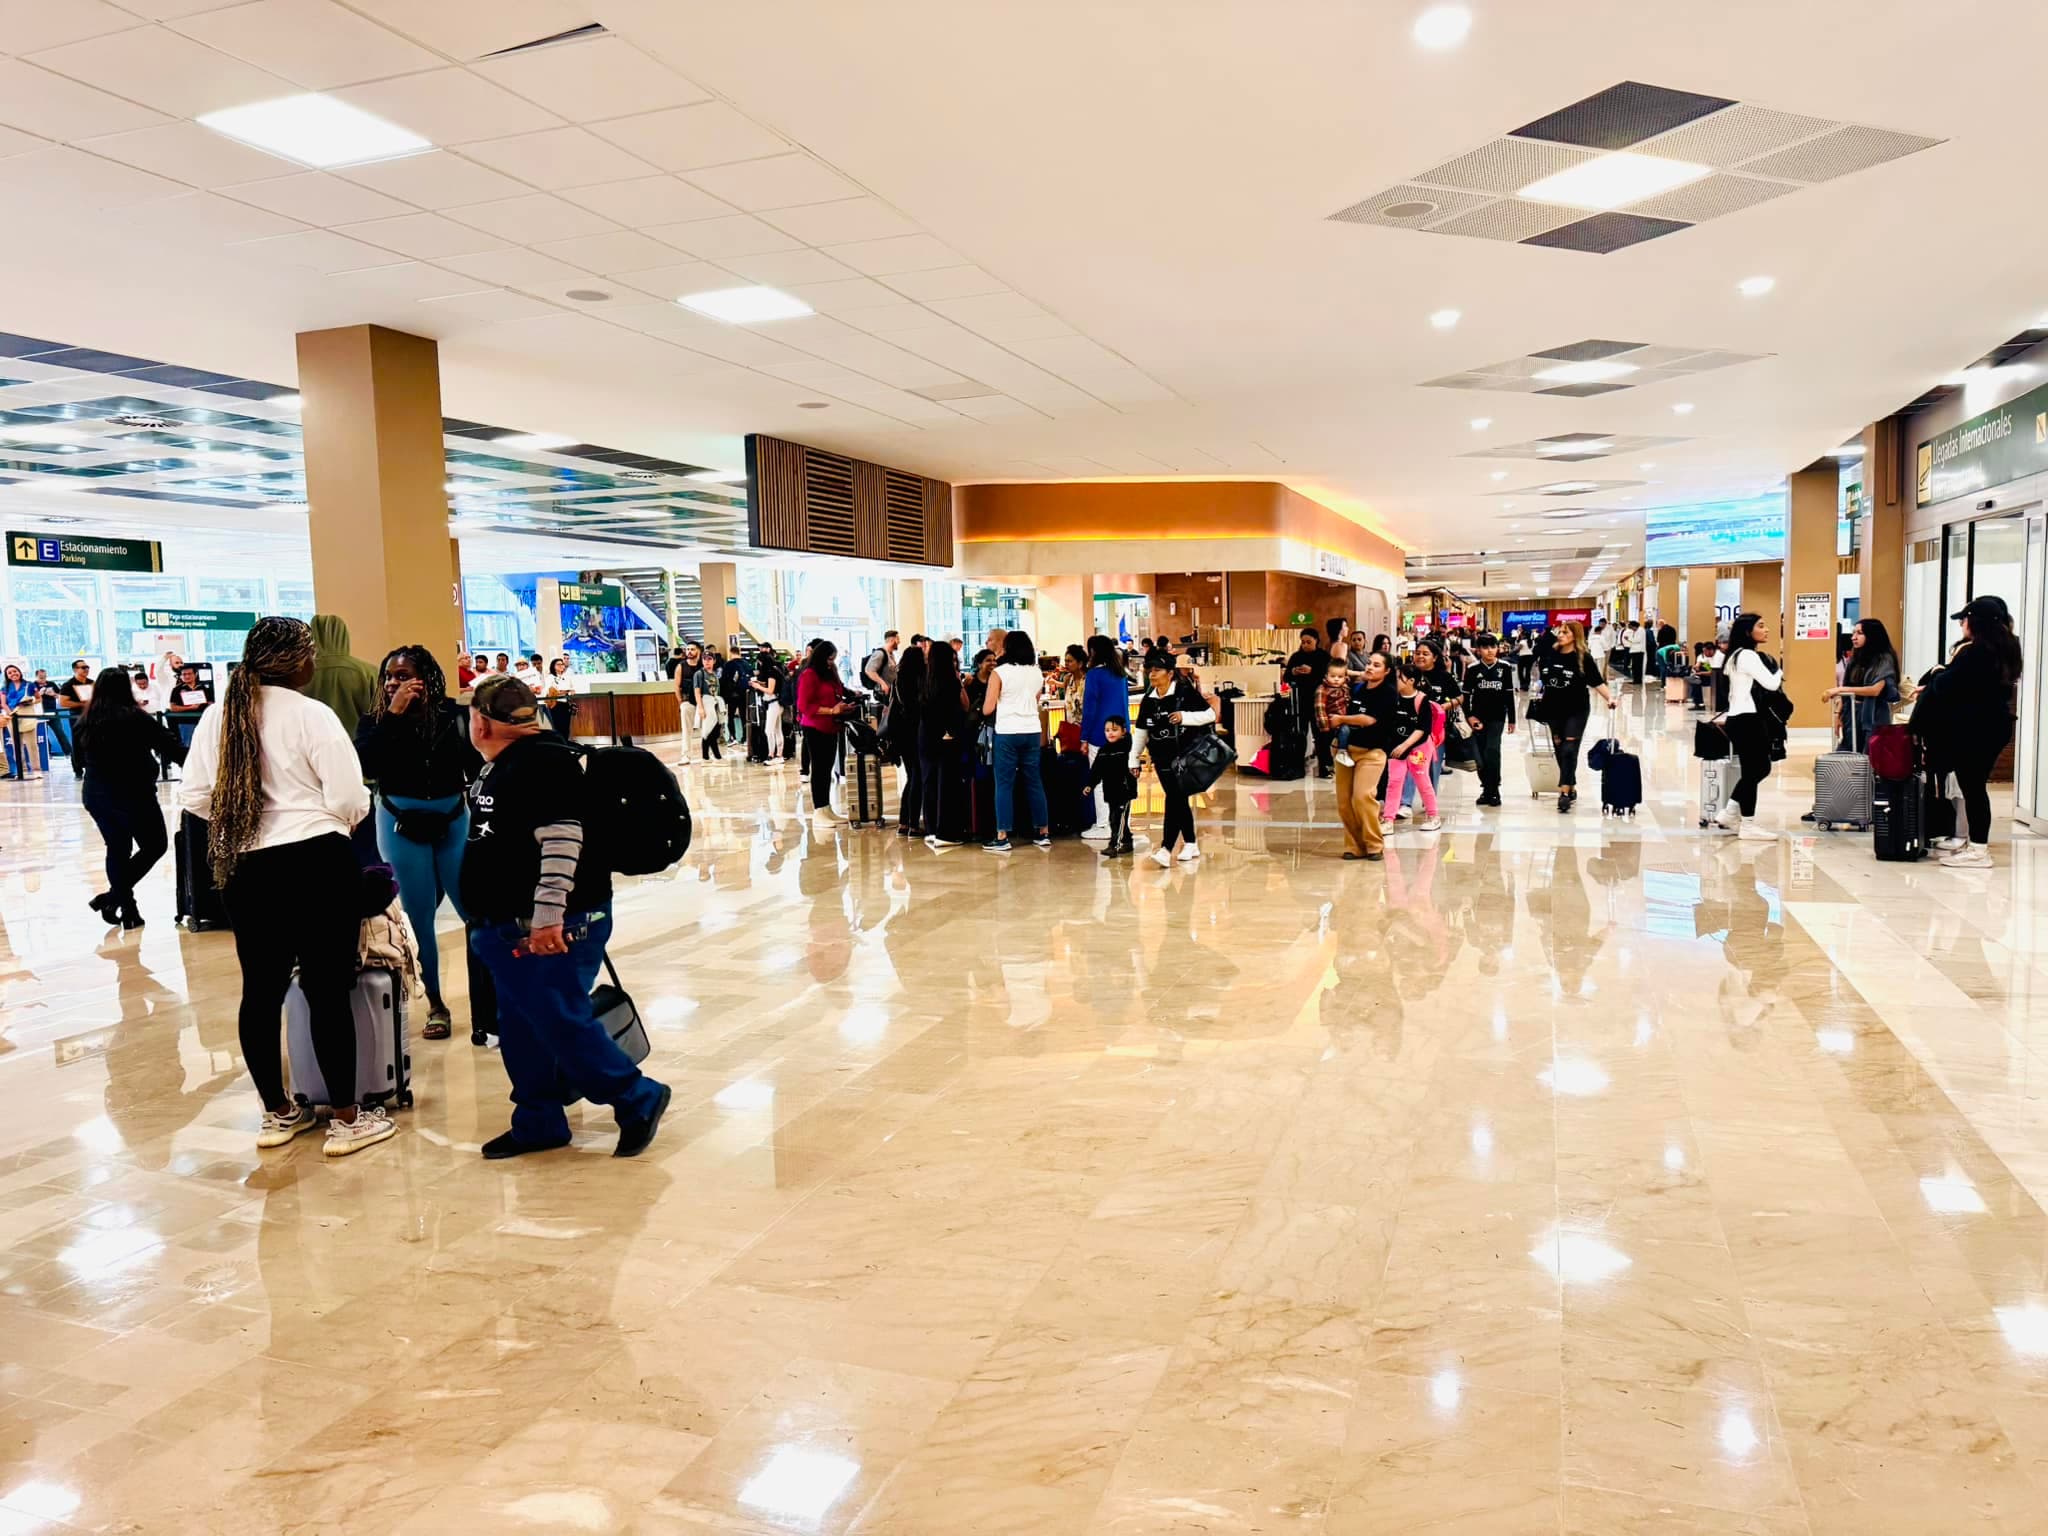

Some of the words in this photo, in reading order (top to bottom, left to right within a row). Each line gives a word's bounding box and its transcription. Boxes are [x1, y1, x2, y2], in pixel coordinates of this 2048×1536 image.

[1932, 432, 1959, 469] Llegadas
[1959, 408, 2012, 454] Internacionales
[43, 543, 55, 558] E
[60, 540, 128, 555] Estacionamiento
[61, 553, 86, 565] Parking
